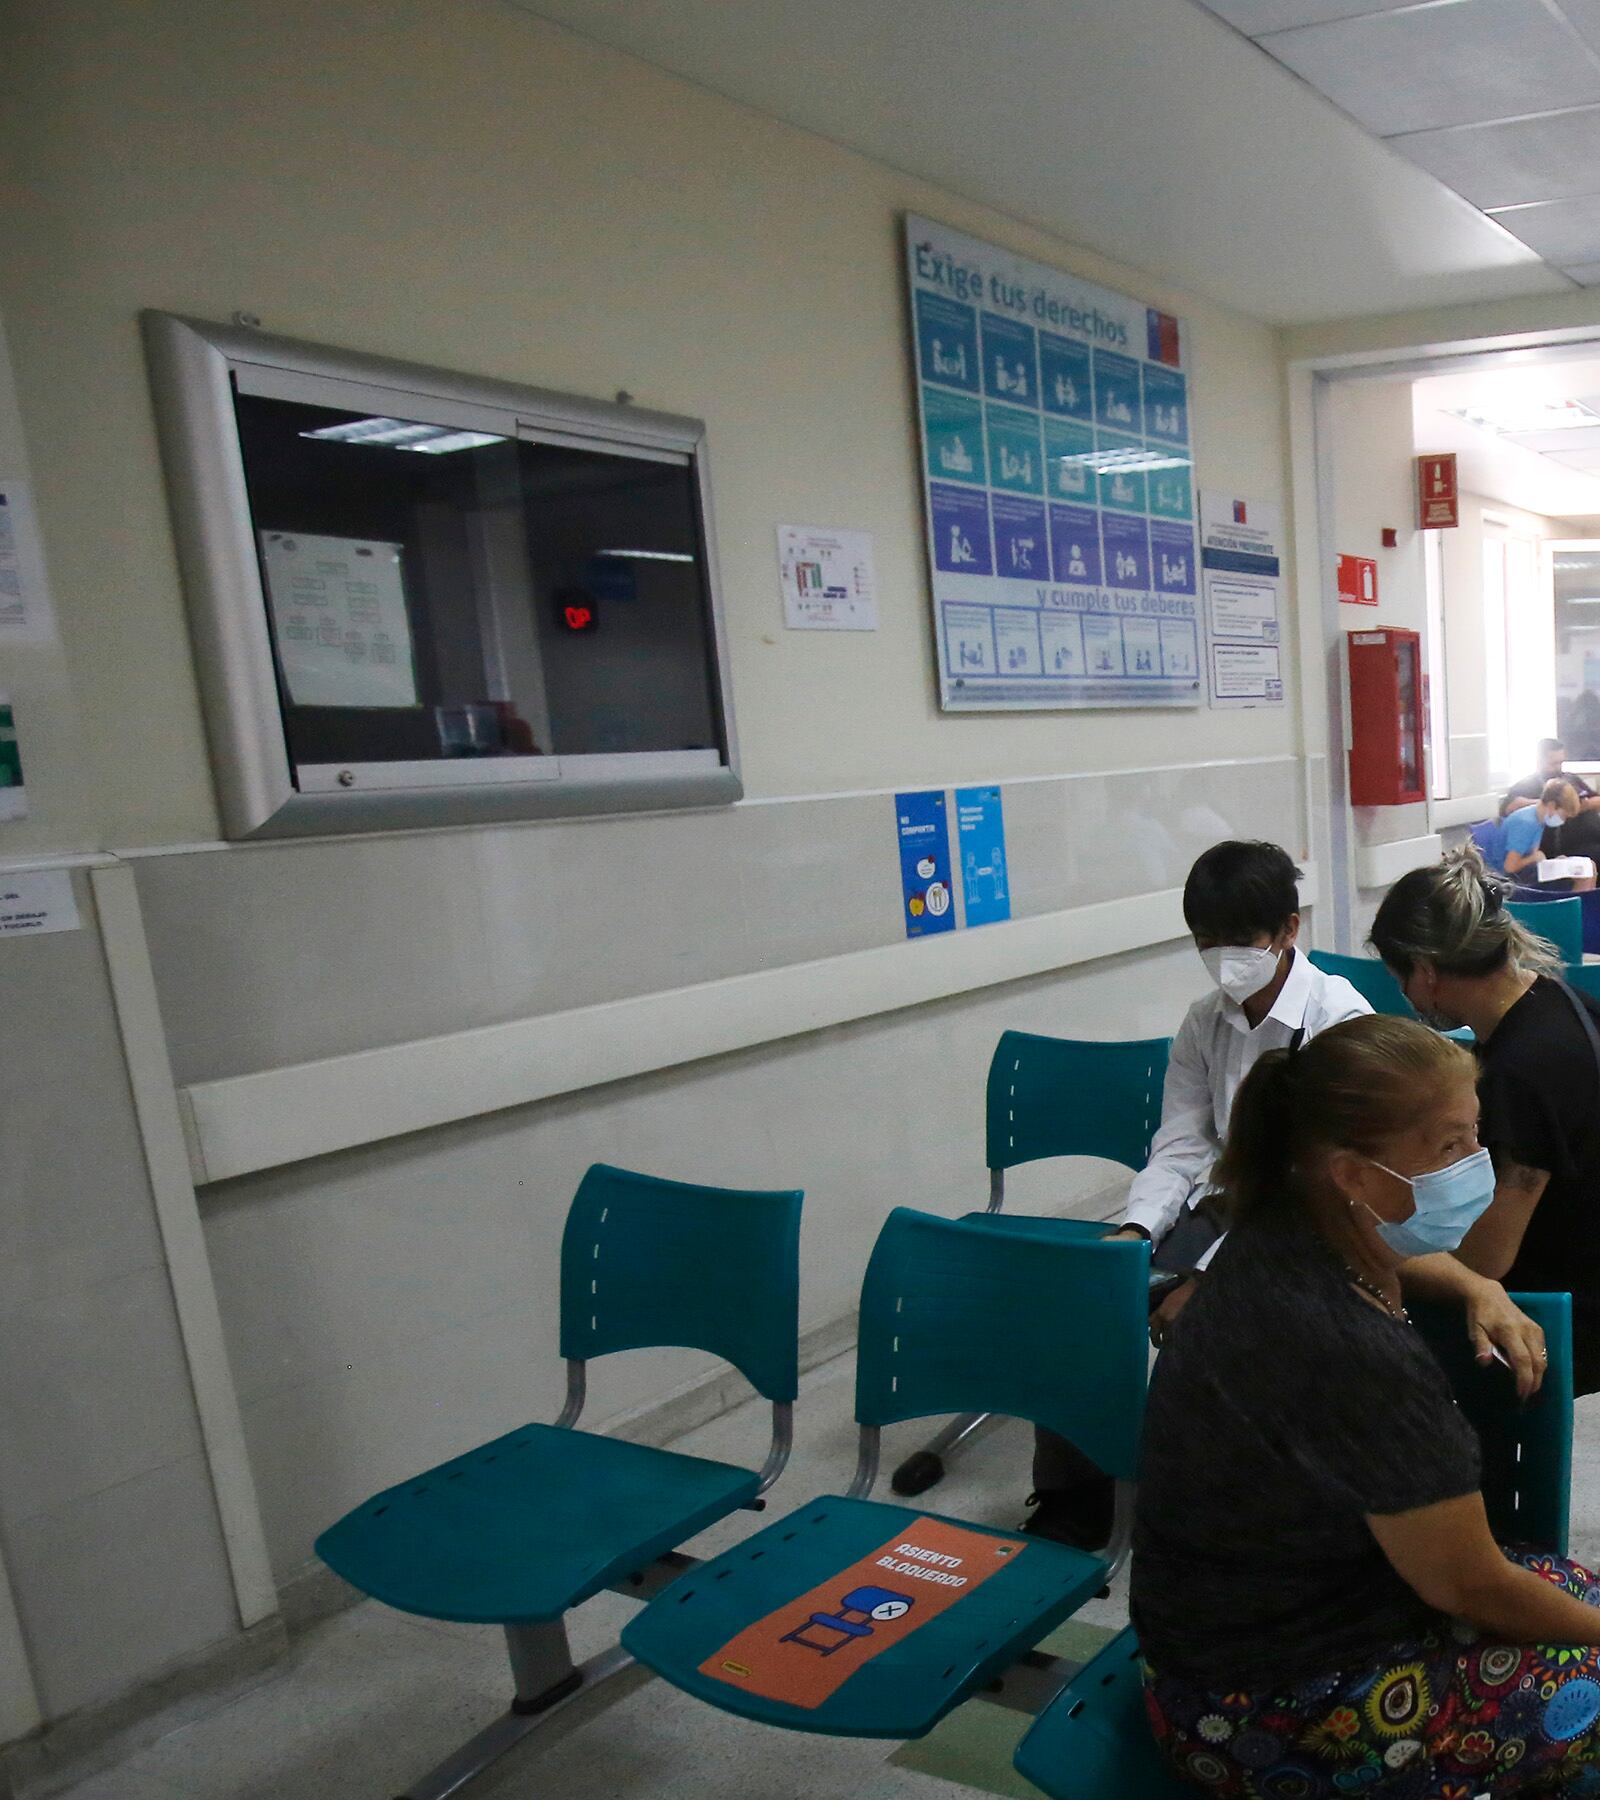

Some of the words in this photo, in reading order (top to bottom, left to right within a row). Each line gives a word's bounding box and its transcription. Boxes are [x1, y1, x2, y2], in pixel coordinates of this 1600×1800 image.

[915, 244, 983, 300] Exige
[990, 274, 1026, 314] tus
[1034, 289, 1127, 346] derechos
[1036, 587, 1047, 608] y
[1051, 588, 1110, 612] cumple
[1114, 592, 1138, 612] tus
[1142, 594, 1196, 616] deberes
[893, 1542, 963, 1569] ASIENTO
[876, 1555, 968, 1588] BLOQUEADO
